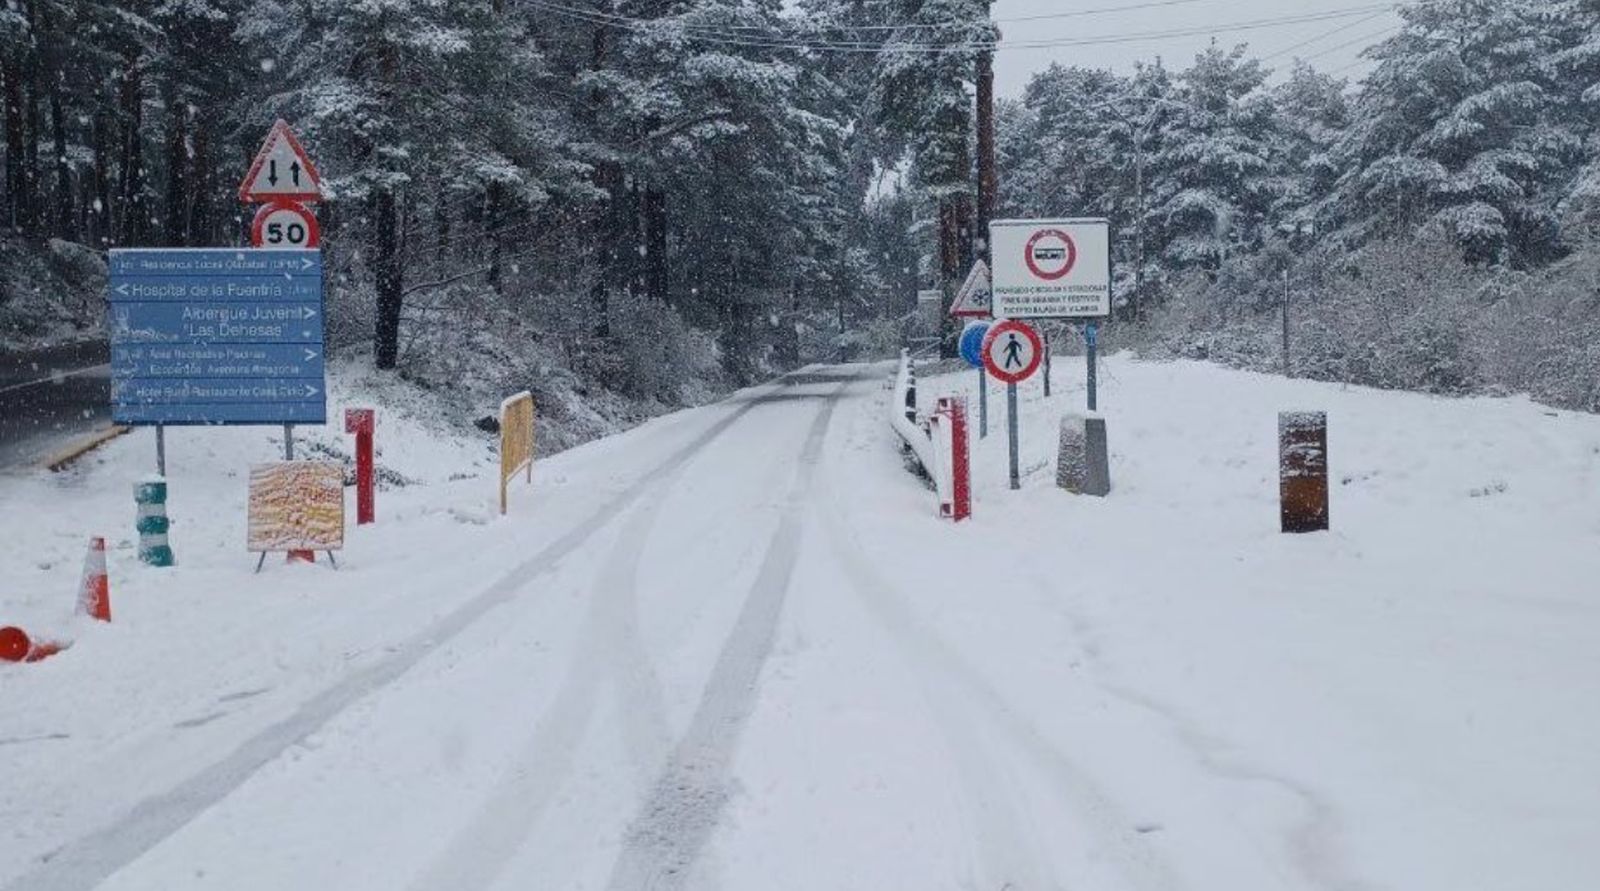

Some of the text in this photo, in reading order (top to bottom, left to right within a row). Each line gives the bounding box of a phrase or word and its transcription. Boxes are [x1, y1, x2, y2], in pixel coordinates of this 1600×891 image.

[268, 223, 305, 244] 50
[132, 284, 186, 299] Hospital
[190, 284, 208, 297] de
[212, 284, 223, 297] la
[182, 306, 302, 323] Albergue Juvenil
